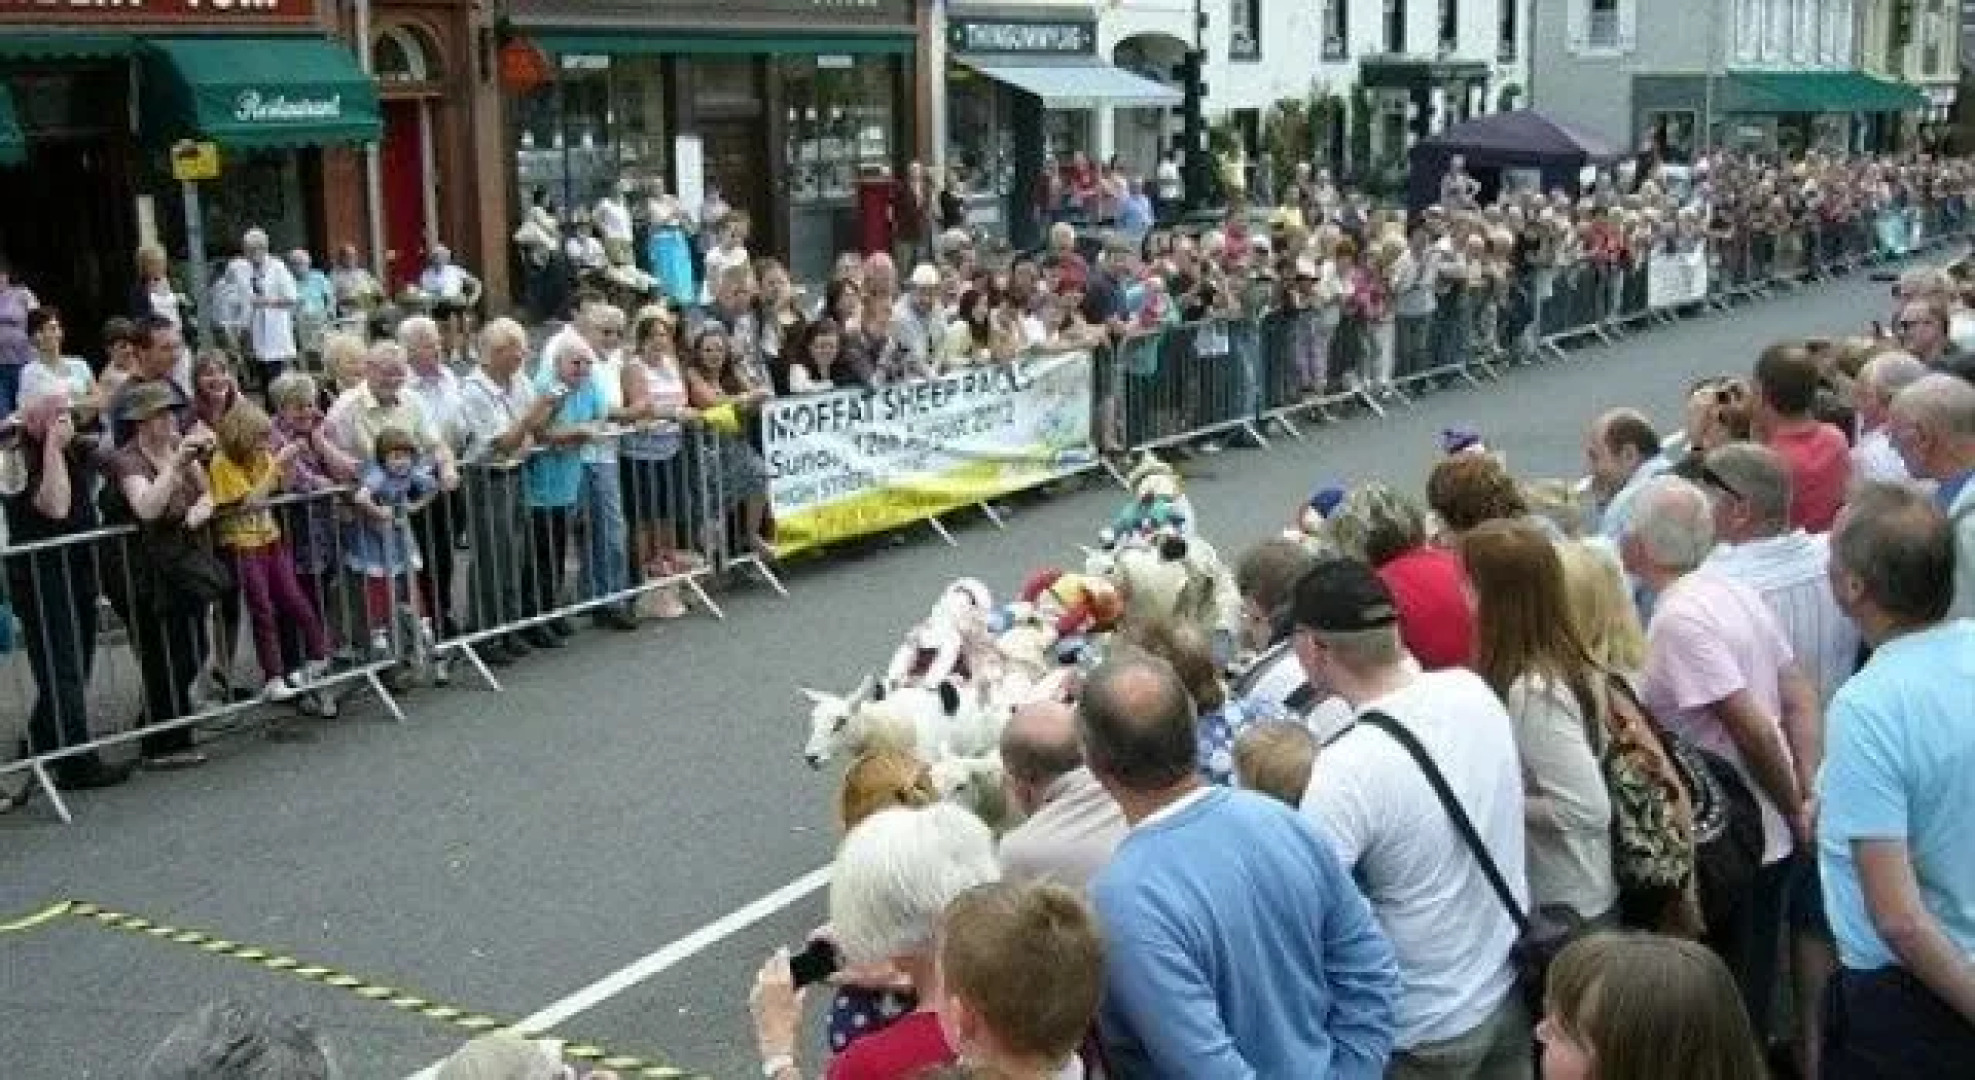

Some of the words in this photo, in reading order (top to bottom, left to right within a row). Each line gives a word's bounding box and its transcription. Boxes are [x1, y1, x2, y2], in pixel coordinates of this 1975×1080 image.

[234, 89, 341, 121] Restaurant
[767, 390, 875, 442] MOFFAT
[884, 379, 959, 422] SHEEP
